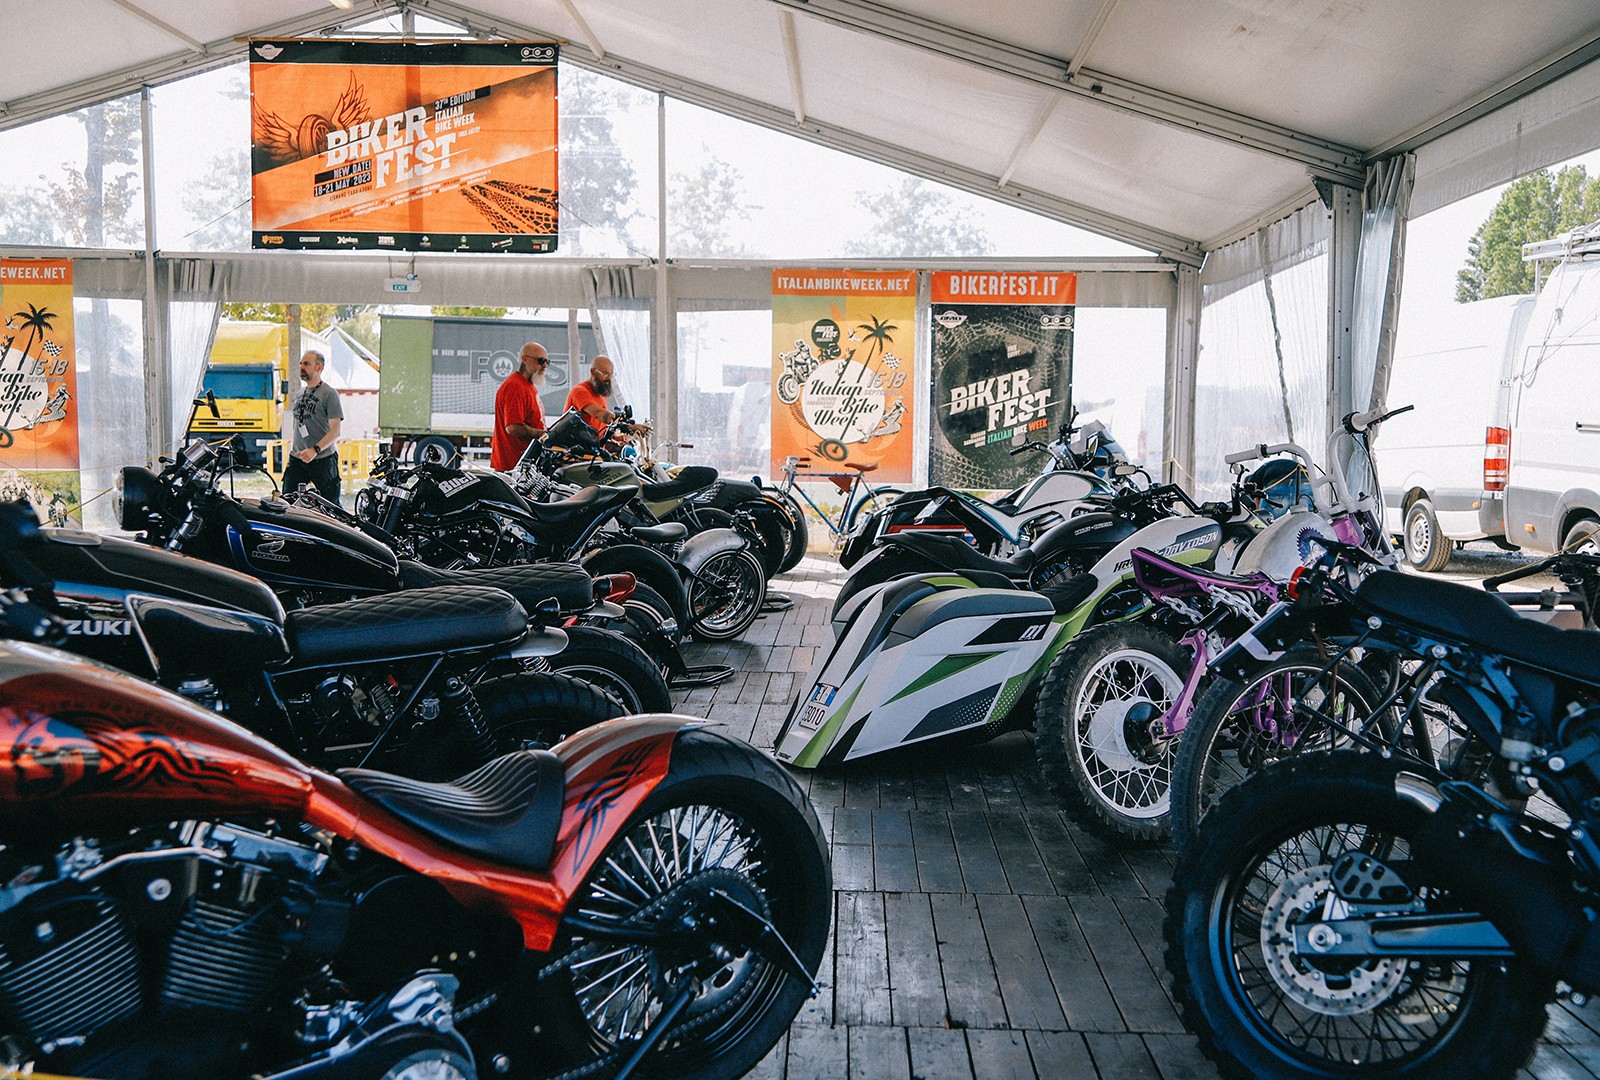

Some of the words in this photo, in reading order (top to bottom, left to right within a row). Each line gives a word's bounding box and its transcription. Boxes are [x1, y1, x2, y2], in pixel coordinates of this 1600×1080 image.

[450, 90, 476, 107] EDITION
[435, 104, 464, 122] ITALIAN
[435, 119, 452, 134] BIKE
[453, 112, 475, 129] WEEK
[325, 106, 430, 168] BIKER
[375, 132, 457, 189] FEST
[333, 165, 351, 179] NEW
[314, 180, 335, 197] 18-21
[335, 177, 351, 191] MAY
[353, 171, 372, 186] 2023
[777, 276, 911, 291] ITALIANBIKEWEEK.NET
[950, 275, 1059, 296] BIKERFEST.IT
[1, 385, 42, 402] Bike
[810, 379, 862, 396] Italian
[949, 368, 1032, 415] BIKER
[839, 397, 879, 414] Bike
[987, 388, 1052, 432] FEST
[814, 409, 859, 426] Week
[987, 429, 1013, 444] ITALIAN
[1013, 424, 1028, 437] BIKE
[1028, 418, 1048, 431] WEEK
[251, 550, 291, 563] HONDA
[66, 620, 132, 636] ZUKI
